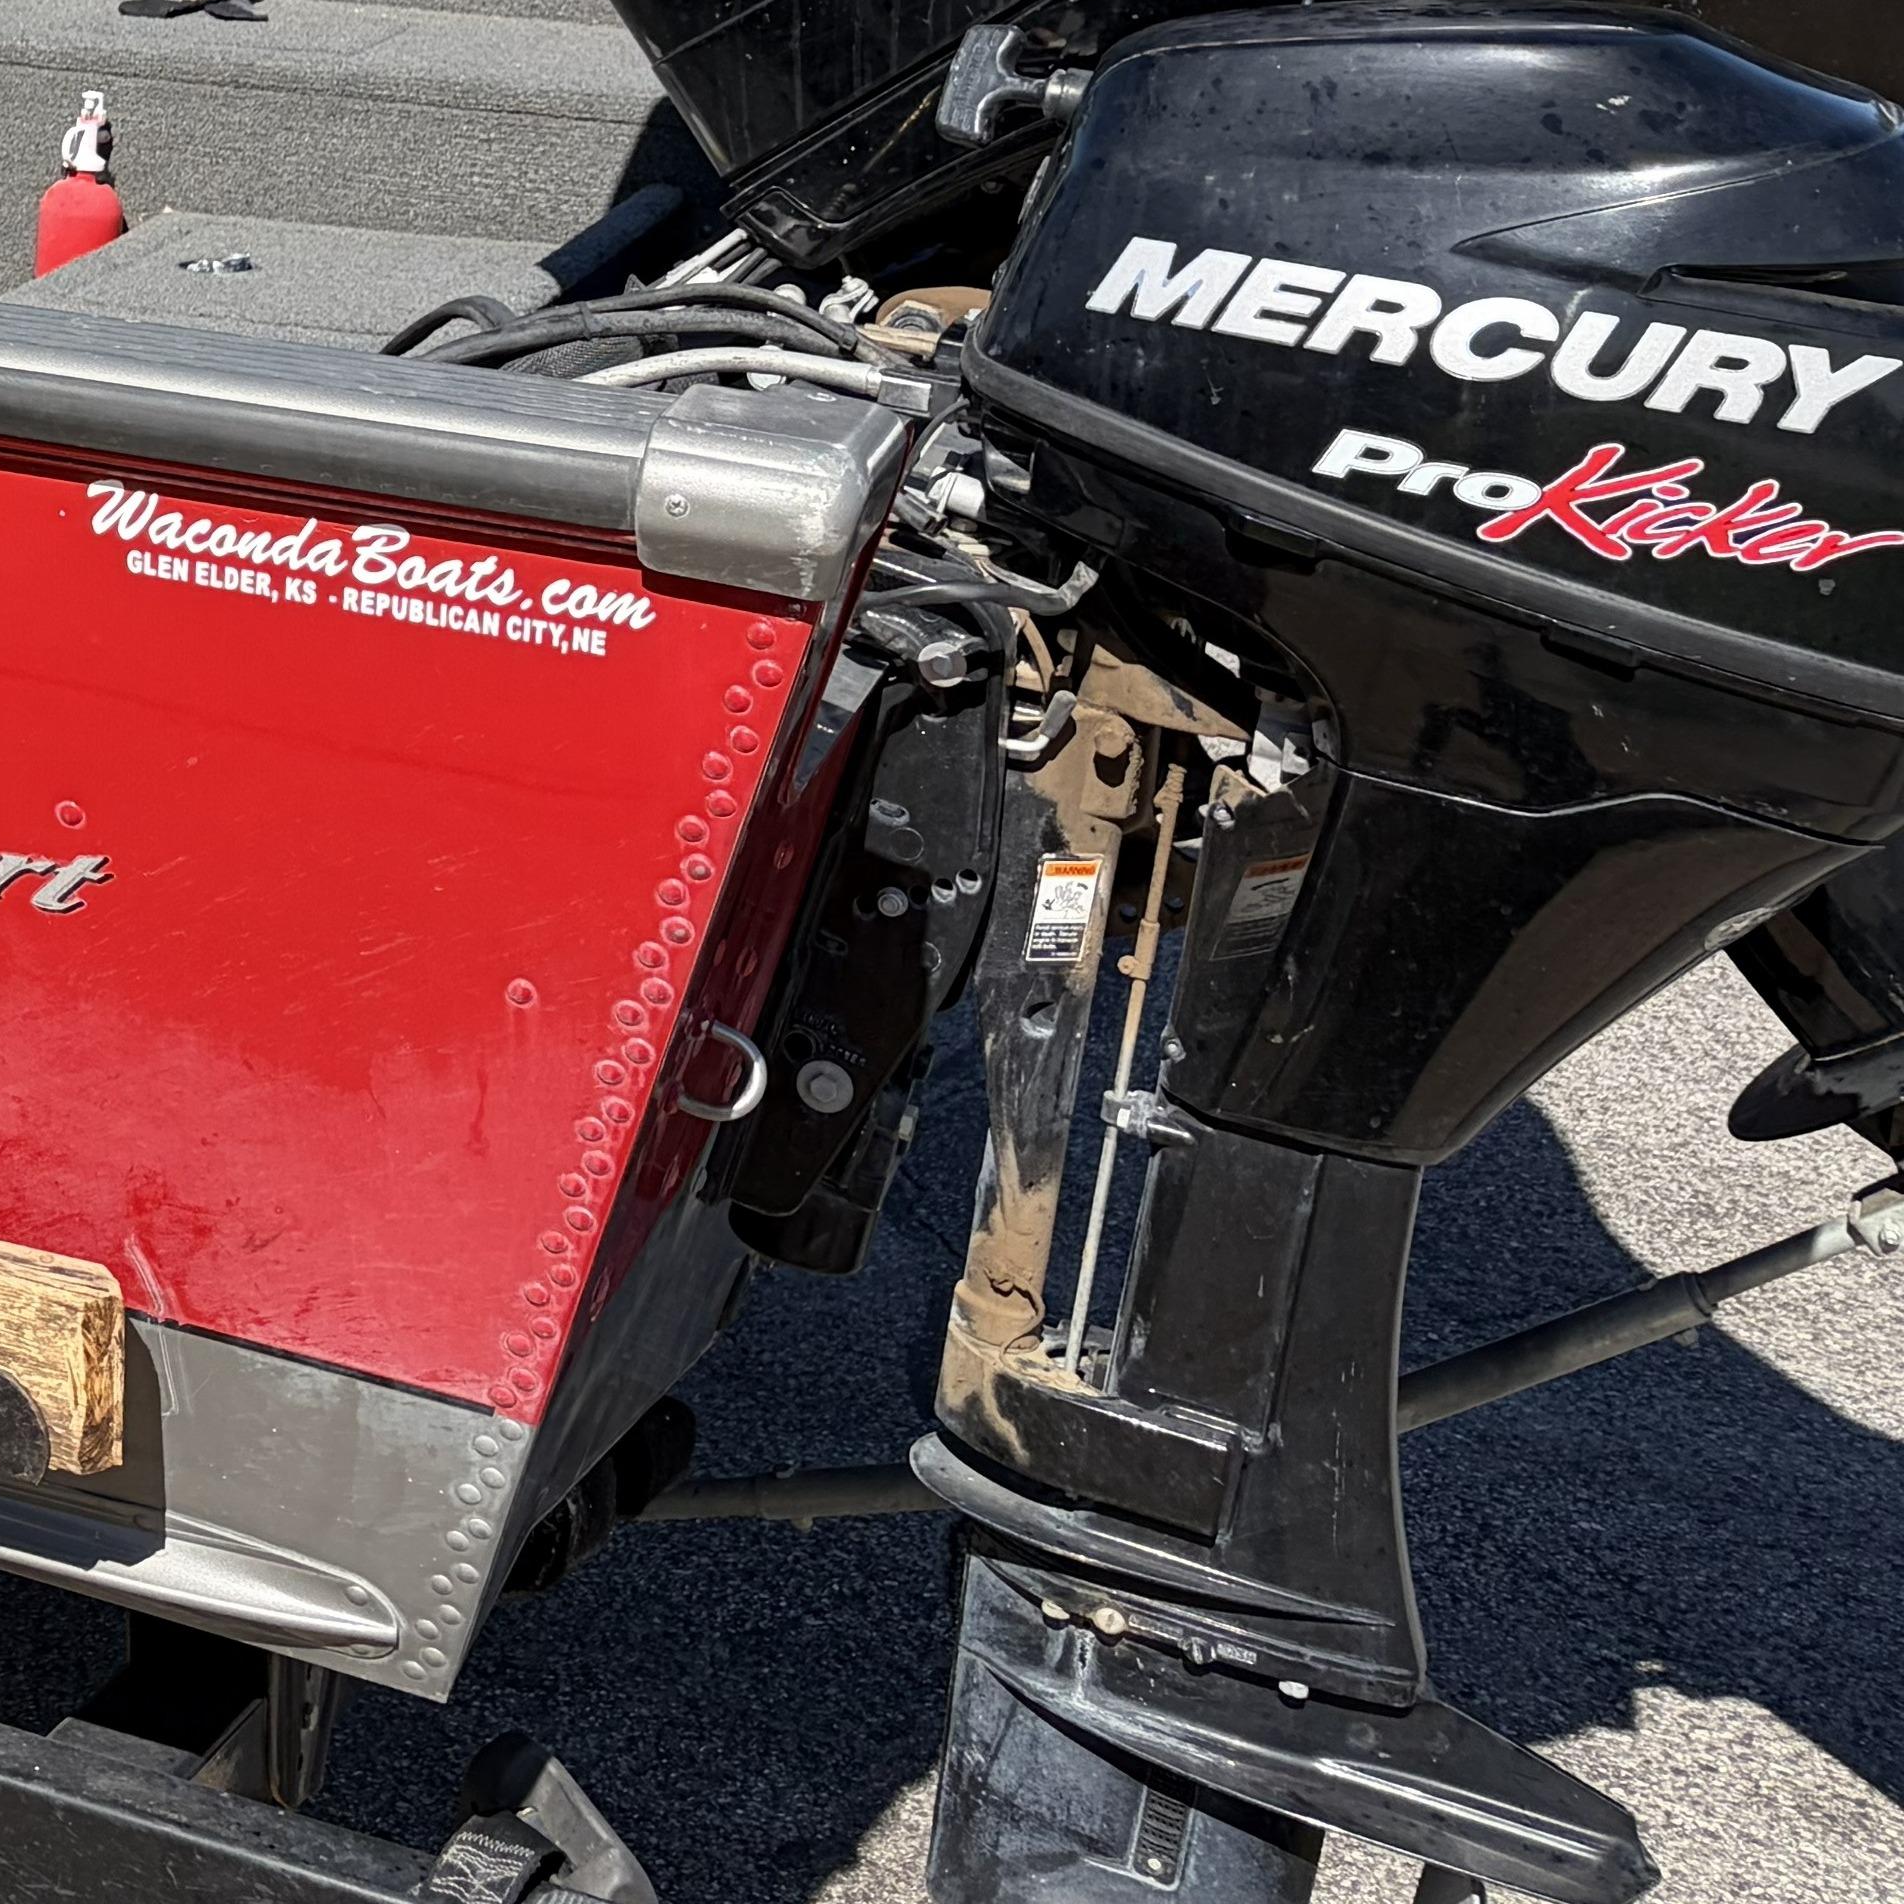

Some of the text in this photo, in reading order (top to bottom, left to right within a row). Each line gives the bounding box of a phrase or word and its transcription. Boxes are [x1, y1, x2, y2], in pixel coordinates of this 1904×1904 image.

[1085, 236, 1903, 434] MERCURY
[126, 550, 189, 582] GLEN
[195, 562, 279, 603] ELDER,
[285, 577, 317, 604] KS
[342, 587, 500, 637] REPUBLICAN
